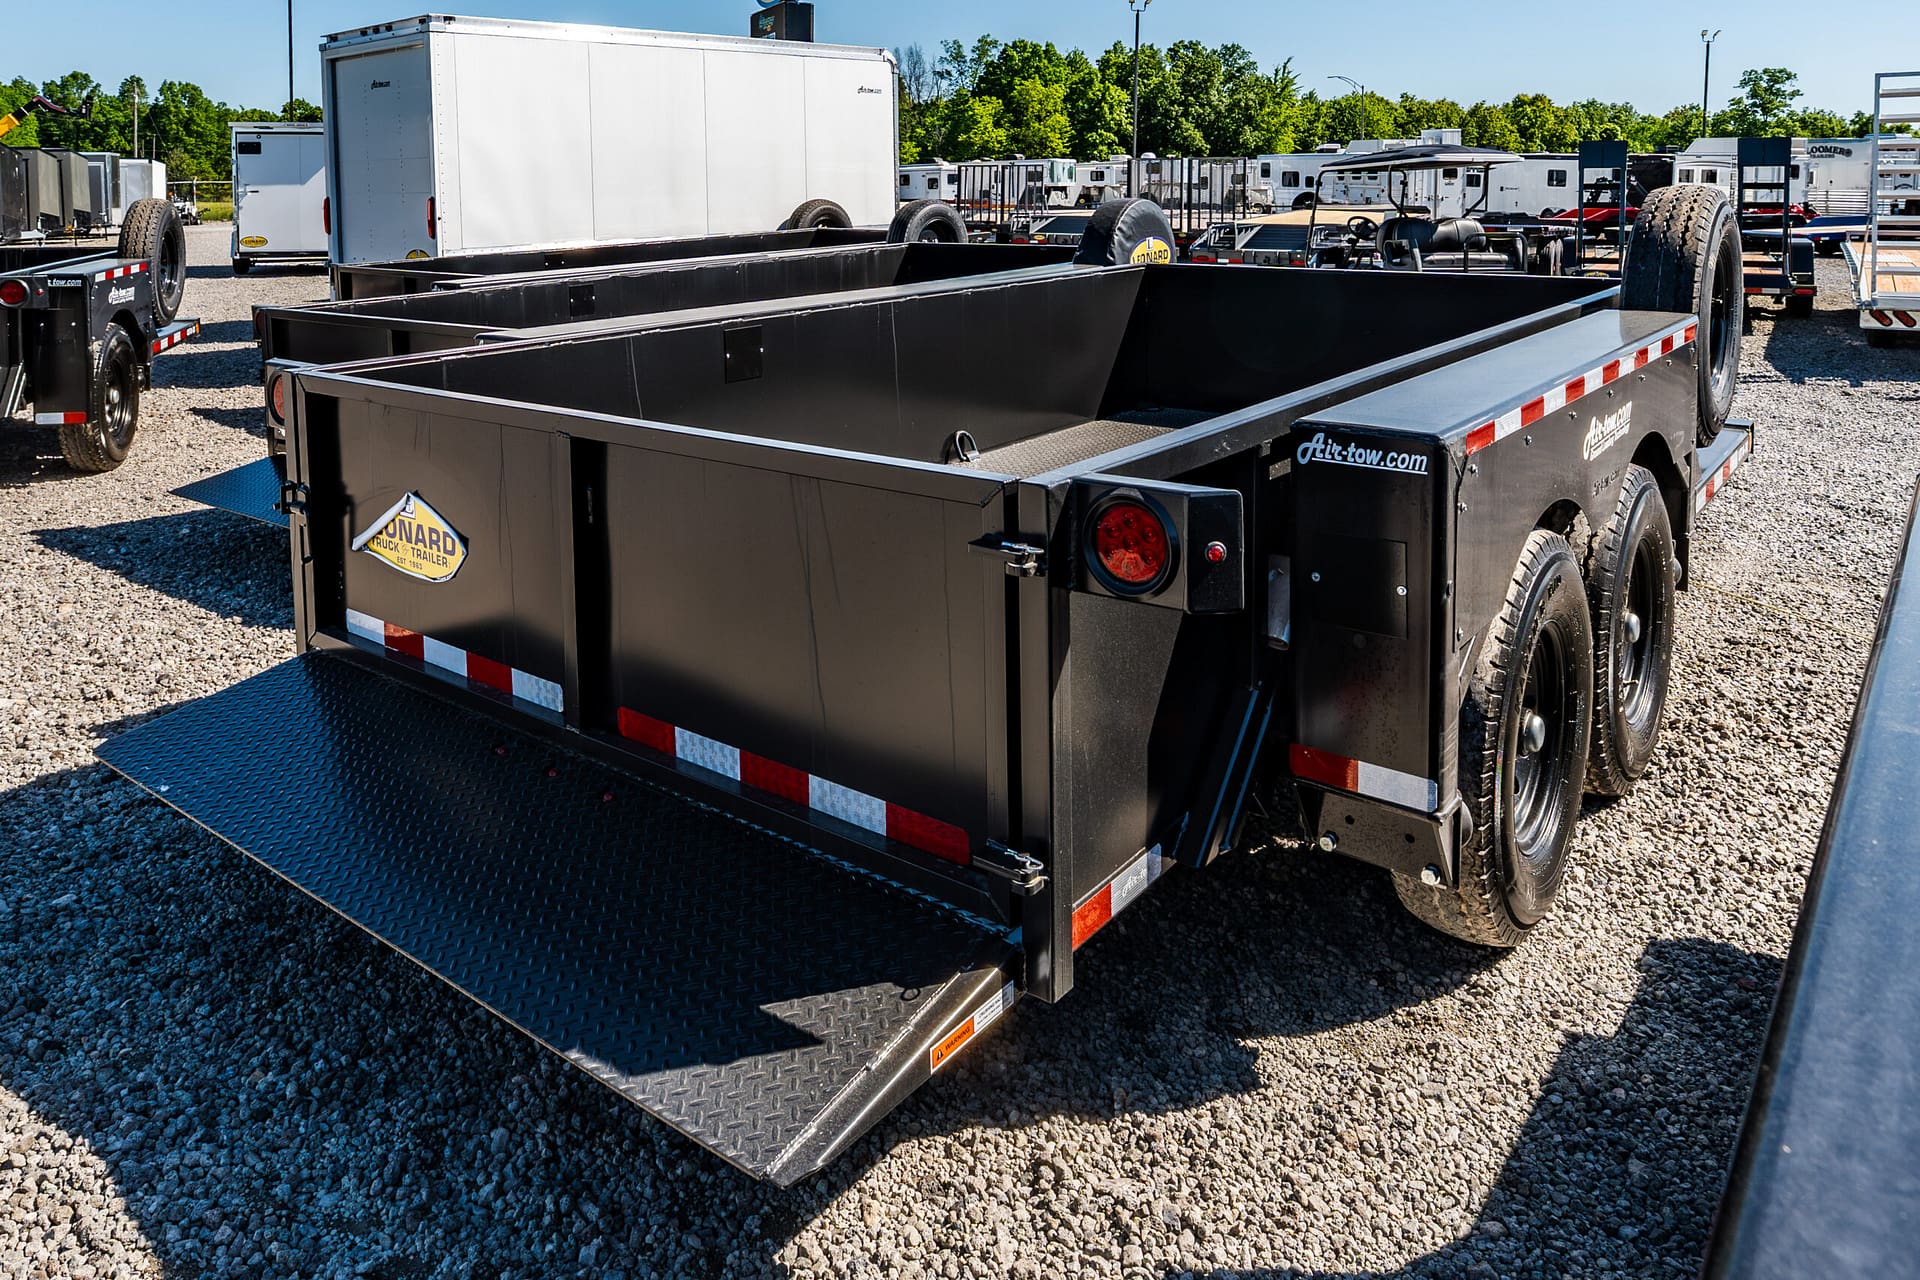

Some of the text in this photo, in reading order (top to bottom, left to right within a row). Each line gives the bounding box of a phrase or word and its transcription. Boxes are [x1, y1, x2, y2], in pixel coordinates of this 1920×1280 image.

[1807, 145, 1845, 156] LOOMER
[1296, 432, 1428, 472] Air-tow.com
[385, 518, 456, 557] ONARD
[411, 546, 448, 568] TRAILER
